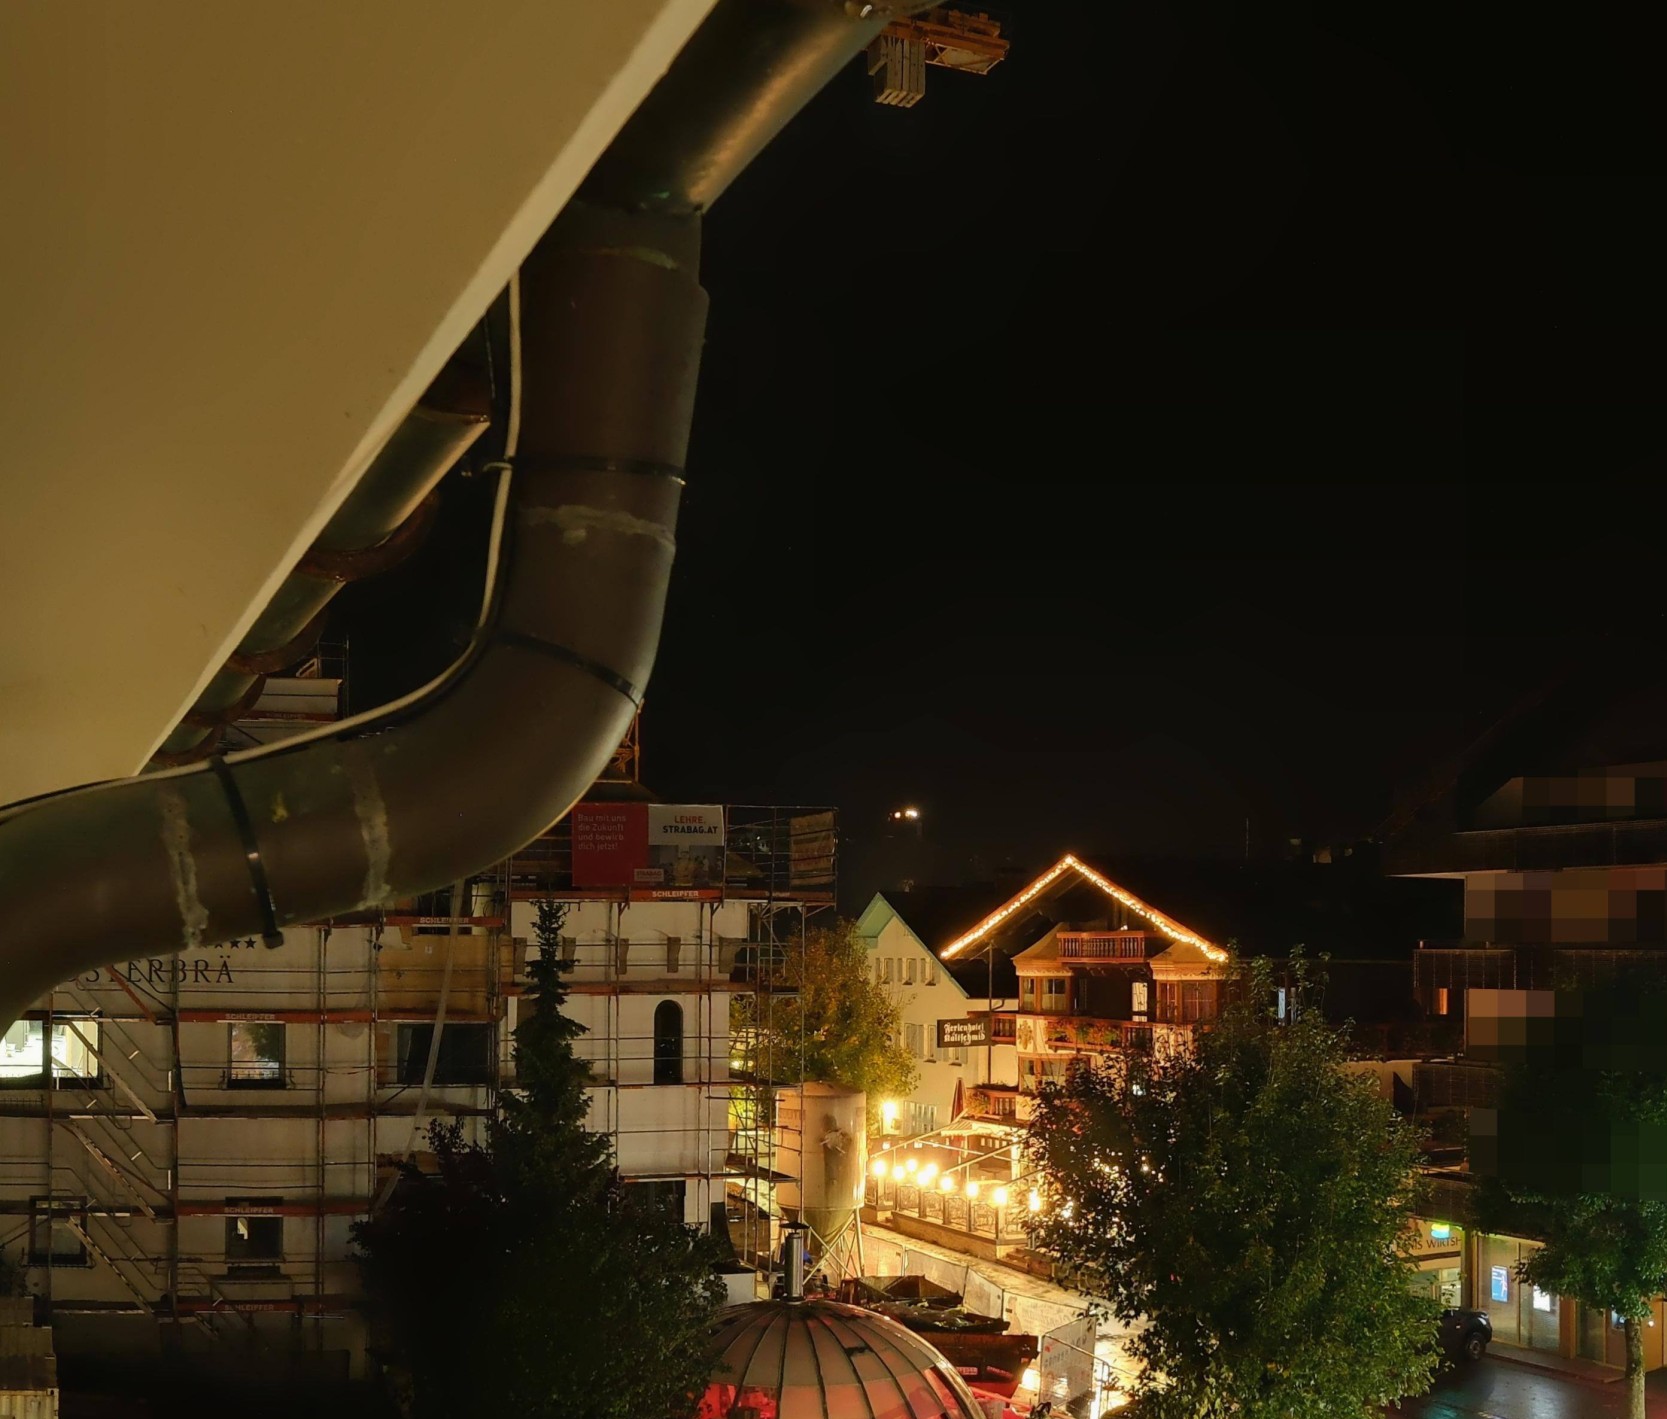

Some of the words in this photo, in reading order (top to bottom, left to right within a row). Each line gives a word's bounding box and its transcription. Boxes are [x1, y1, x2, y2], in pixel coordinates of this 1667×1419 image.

[592, 823, 624, 831] Zukunft
[663, 825, 718, 834] STRABAG.AT
[652, 890, 699, 898] SCHLEIPFER
